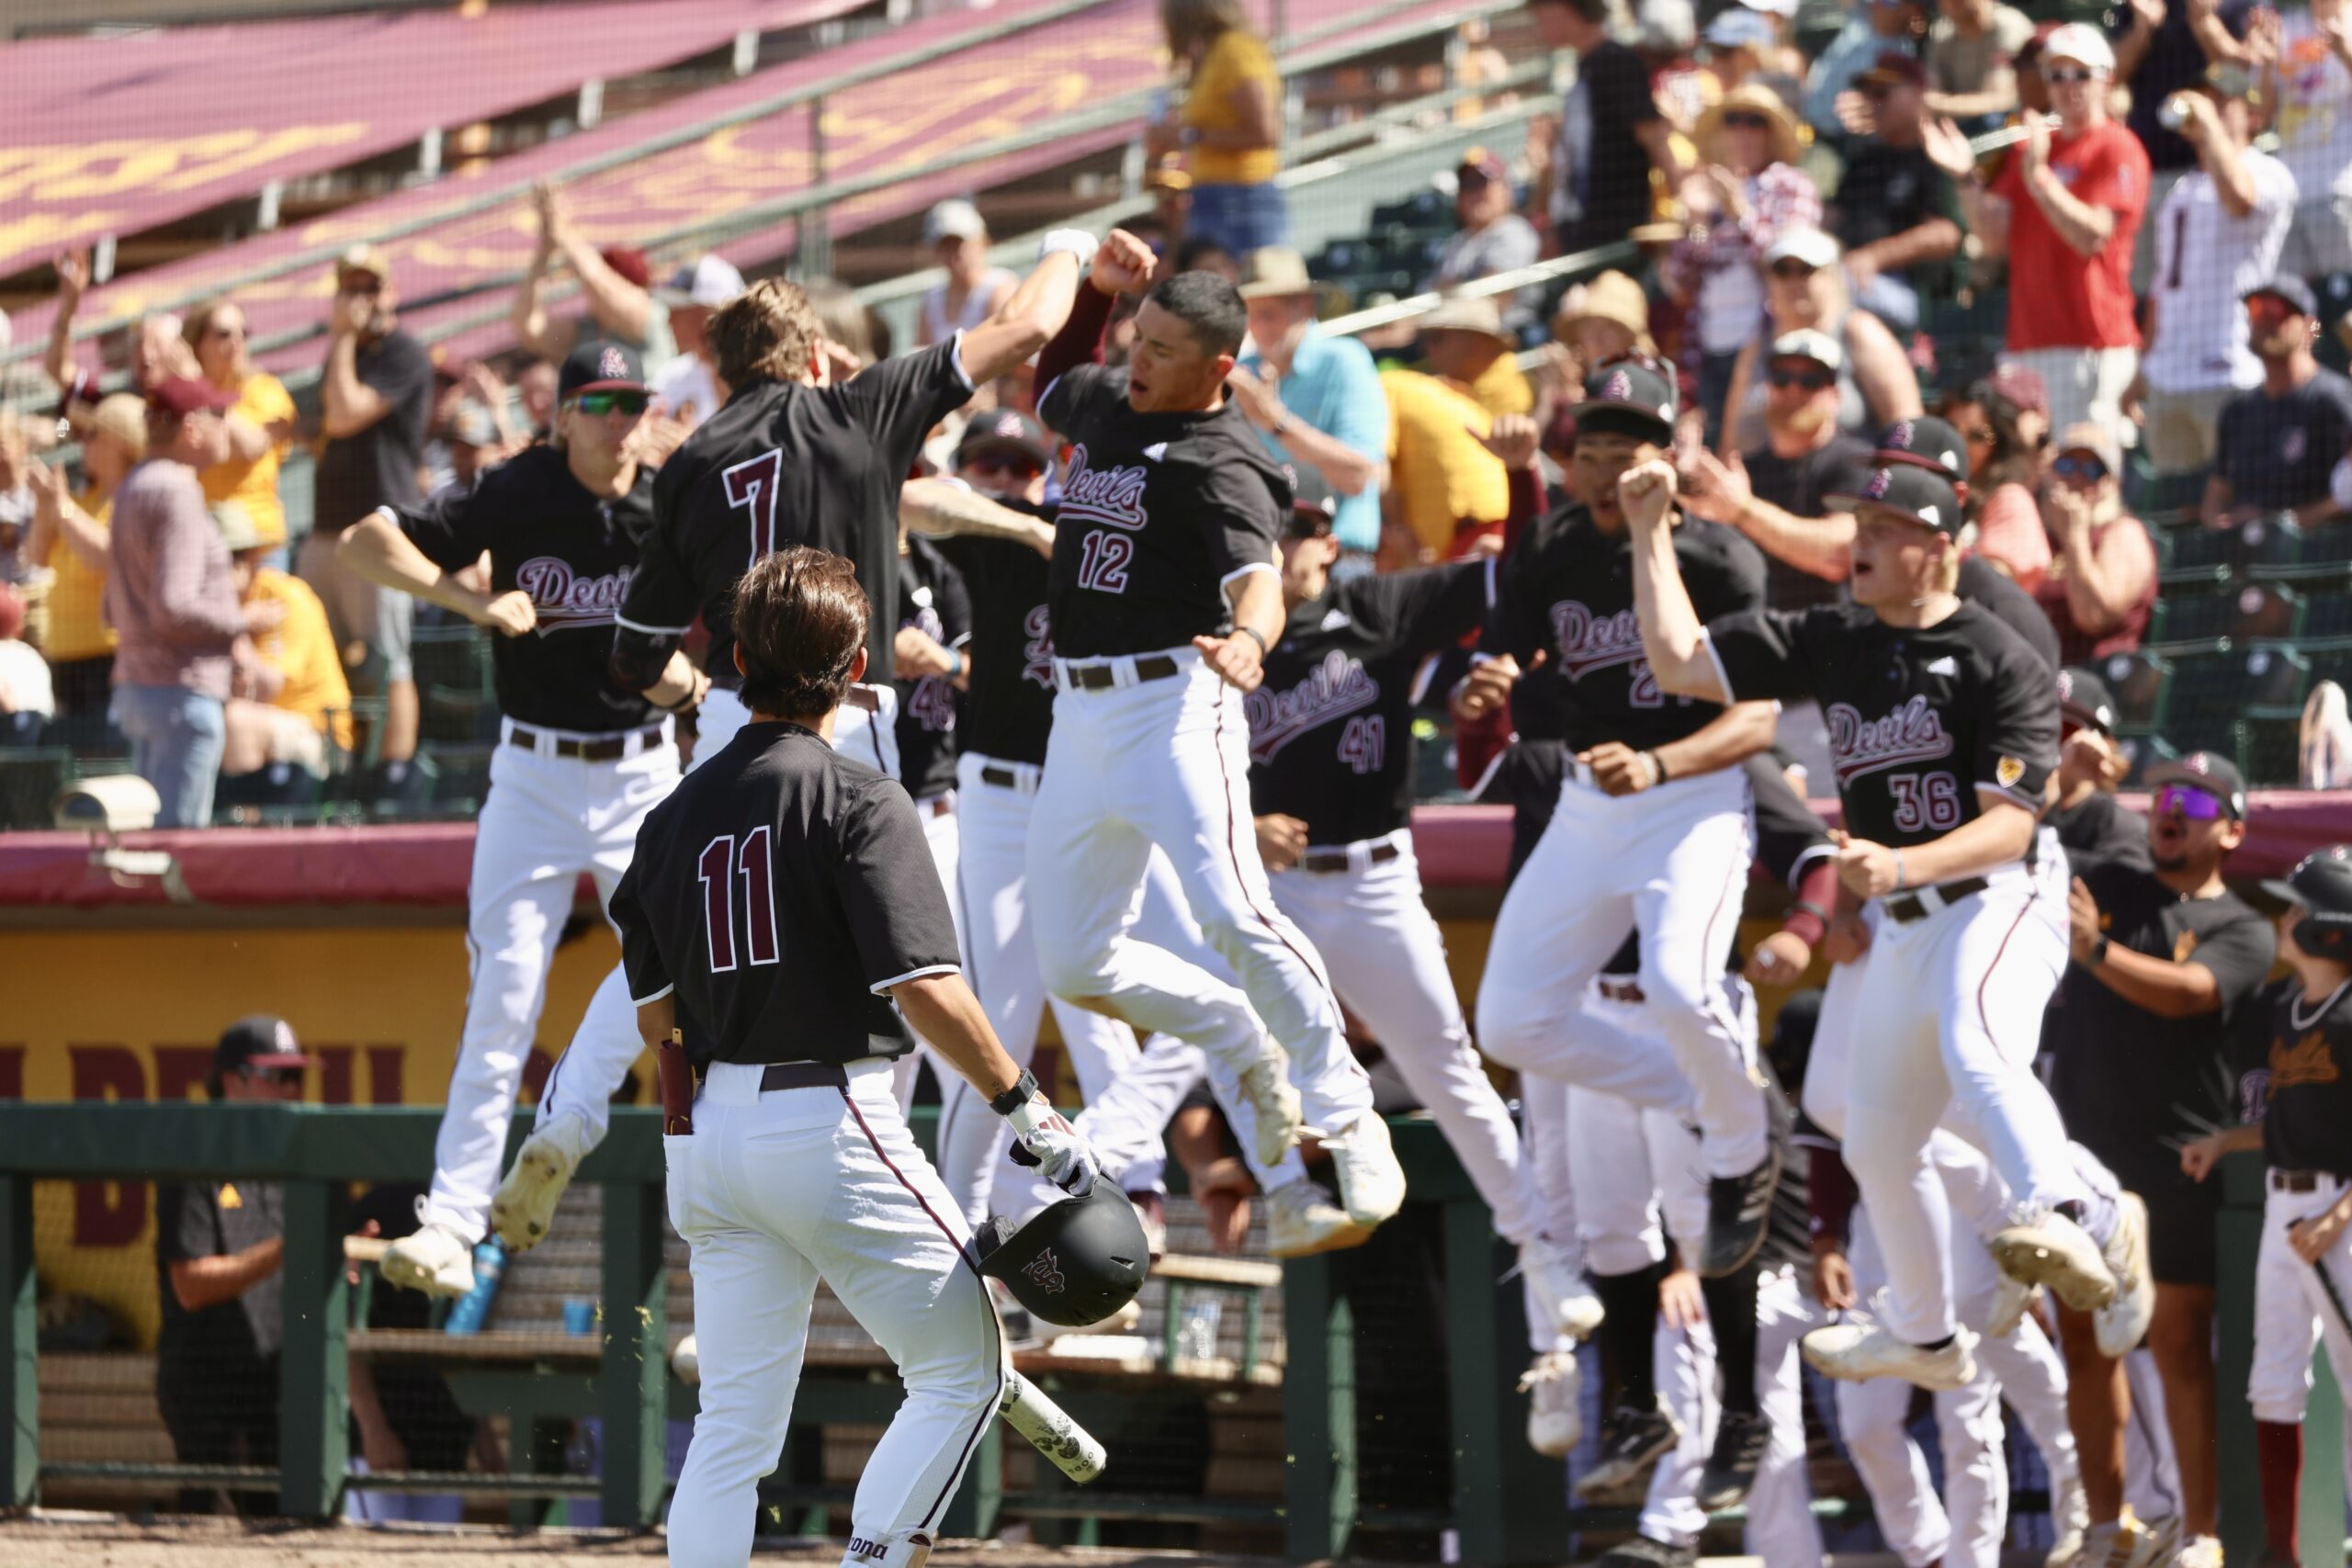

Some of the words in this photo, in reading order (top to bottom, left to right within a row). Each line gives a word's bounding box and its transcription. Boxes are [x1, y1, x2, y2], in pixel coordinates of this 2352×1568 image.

[721, 446, 783, 570] 7
[1078, 529, 1134, 594] 12
[1337, 714, 1385, 773] 41
[1826, 694, 1954, 772] Devils
[1888, 771, 1961, 832] 36
[697, 824, 780, 973] 11
[848, 1536, 888, 1561] ona
